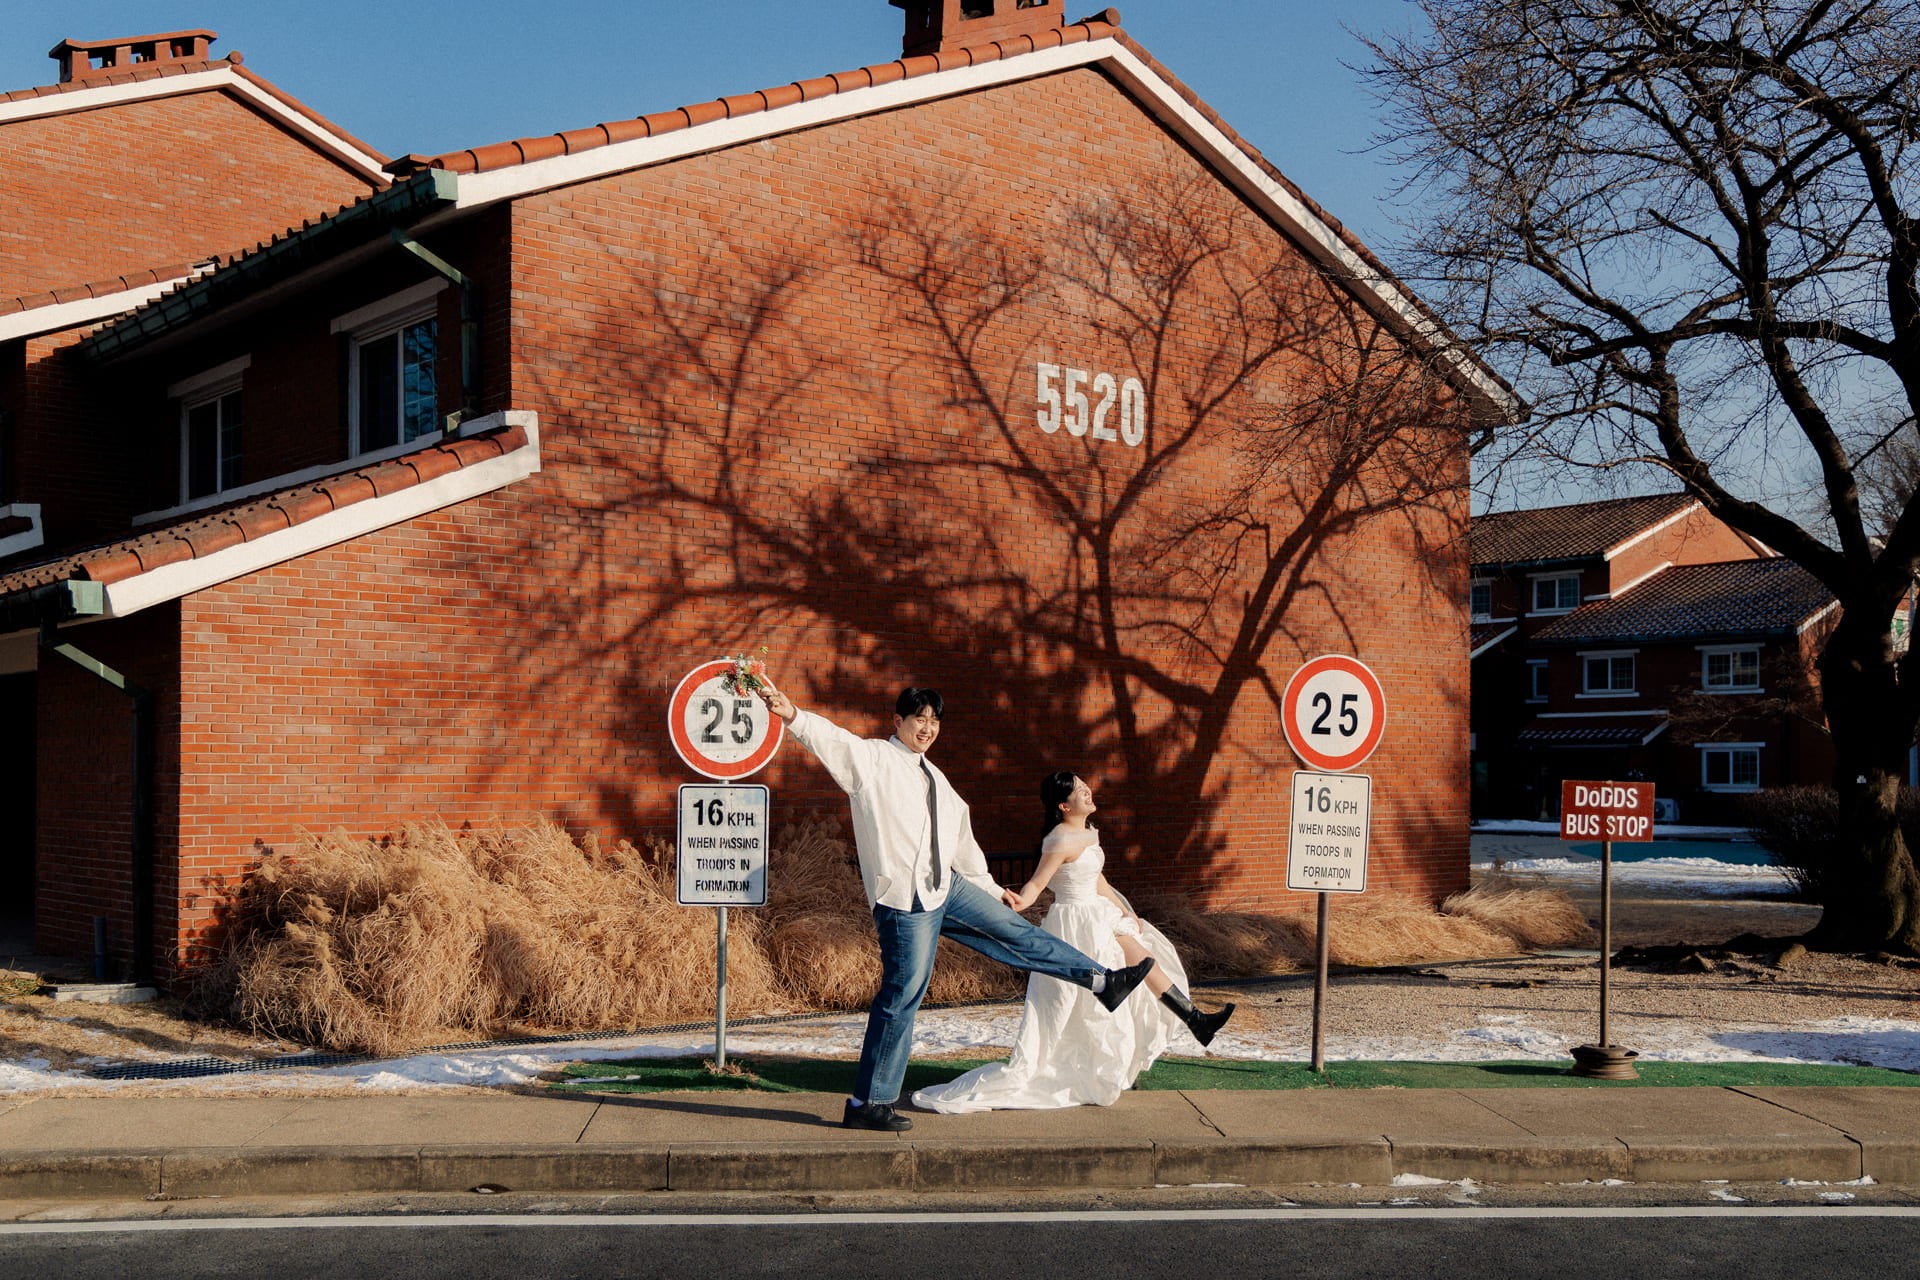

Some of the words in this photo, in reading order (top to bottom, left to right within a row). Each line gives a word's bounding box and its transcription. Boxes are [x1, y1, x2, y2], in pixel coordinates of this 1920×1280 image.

[1037, 362, 1145, 447] 5520
[700, 698, 753, 744] 25
[1311, 691, 1358, 737] 25
[1304, 786, 1331, 814] 16
[1334, 800, 1357, 815] KPH
[1575, 785, 1638, 809] DoDDS
[693, 799, 724, 827] 16
[727, 812, 754, 828] KPH
[1566, 813, 1600, 836] BUS
[1606, 815, 1649, 837] STOP
[1298, 823, 1324, 836] WHEN
[1326, 824, 1361, 838] PASSING
[688, 836, 716, 849] WHEN
[719, 836, 759, 850] PASSING
[1305, 844, 1340, 858] TROOPS
[1343, 847, 1352, 859] IN
[696, 858, 736, 871] TROOPS
[740, 858, 750, 871] IN
[1303, 865, 1351, 879] FORMATION
[695, 879, 750, 893] FORMATION
